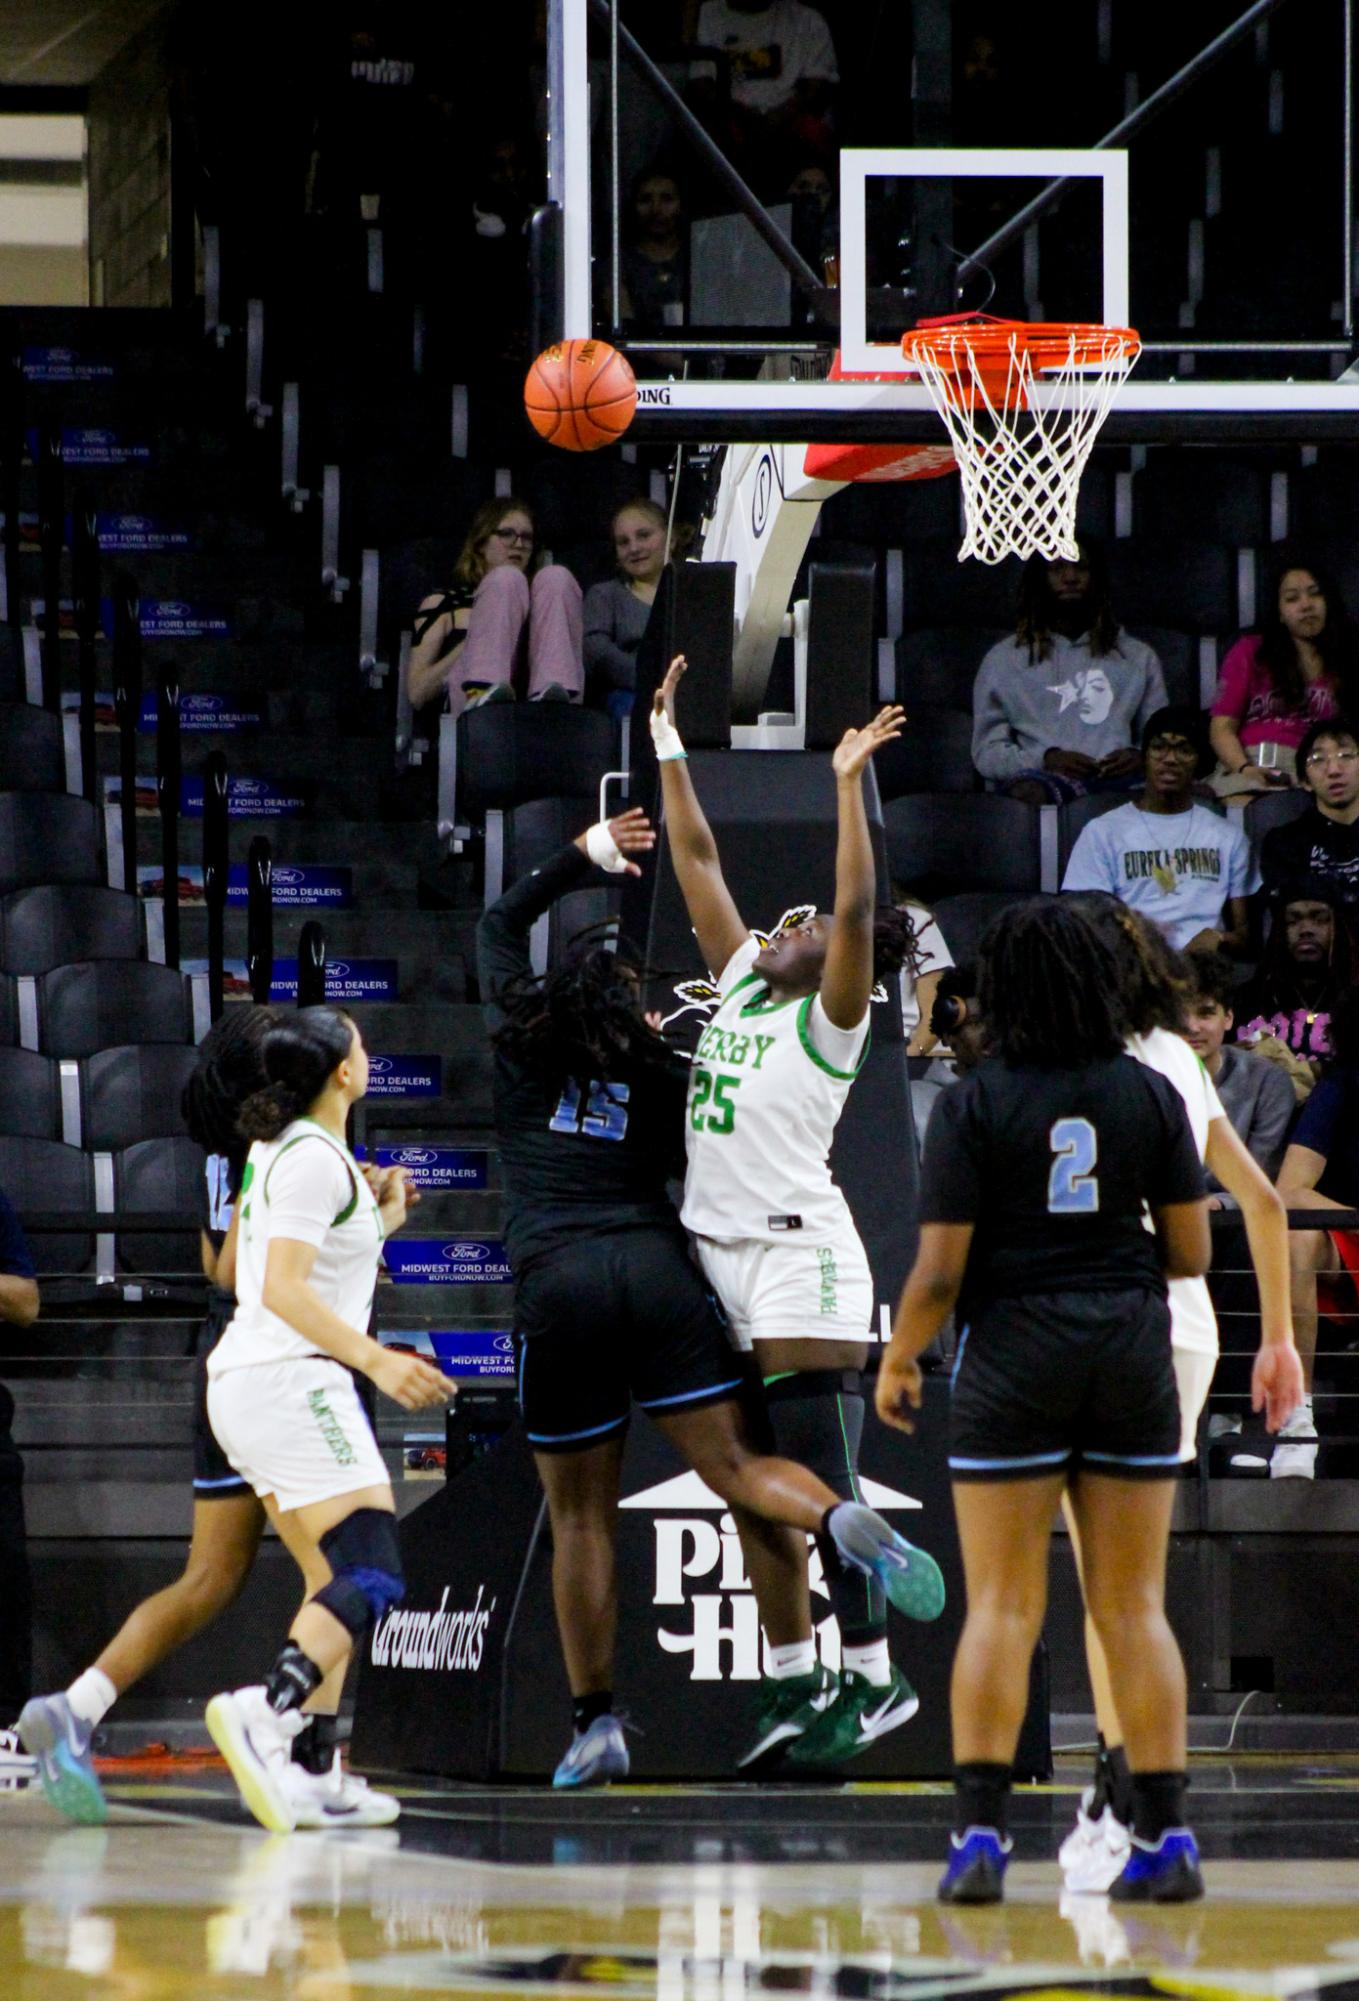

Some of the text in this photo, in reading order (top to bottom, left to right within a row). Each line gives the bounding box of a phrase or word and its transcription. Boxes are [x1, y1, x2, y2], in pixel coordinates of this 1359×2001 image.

[158, 620, 184, 629] FORD
[185, 620, 229, 629] DEALERS
[188, 713, 215, 722] FORD
[218, 713, 260, 722] DEALERS
[234, 798, 263, 807] FORD
[263, 798, 306, 807] DEALERS
[271, 888, 298, 896] FORD
[300, 887, 343, 896] DEALERS
[344, 981, 389, 990] DEALERS
[387, 1076, 432, 1086] DEALERS
[690, 1068, 742, 1135] 25
[548, 1075, 631, 1141] 15
[1047, 1116, 1099, 1213] 2
[407, 1168, 478, 1178] ORD DEALERS
[401, 1263, 512, 1273] MIDWEST FORD DEAL
[428, 1273, 504, 1281] BUYFORDNOW.COM
[451, 1355, 501, 1365] MIDWEST
